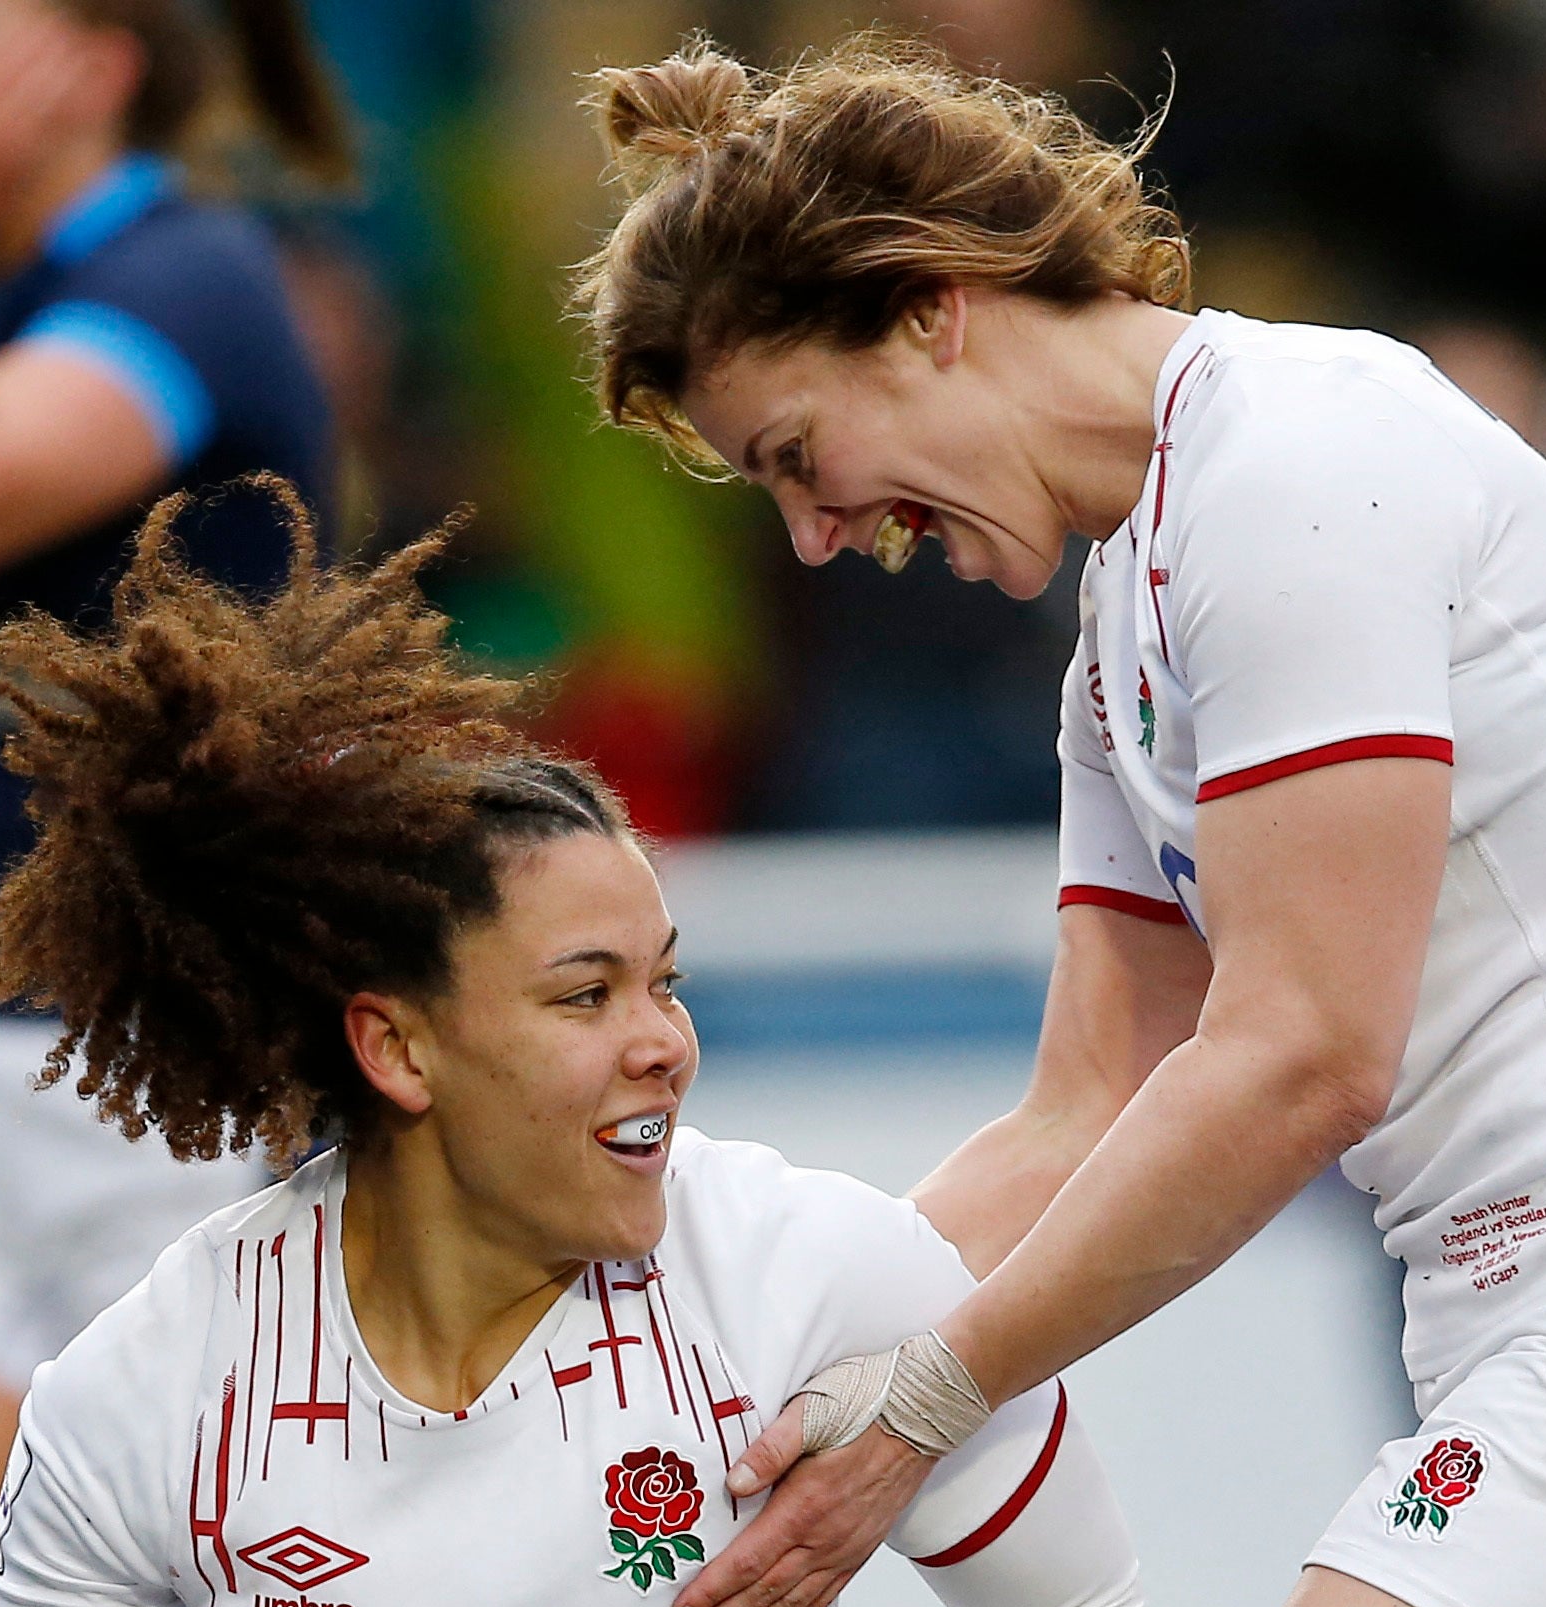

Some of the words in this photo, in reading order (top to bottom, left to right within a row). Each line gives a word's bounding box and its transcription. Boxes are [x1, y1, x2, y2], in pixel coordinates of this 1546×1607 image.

[1450, 1208, 1489, 1226] Sarah
[1487, 1195, 1531, 1215] Hunter
[1441, 1223, 1488, 1246] England
[1489, 1221, 1504, 1233] vs
[1490, 1264, 1519, 1285] Caps
